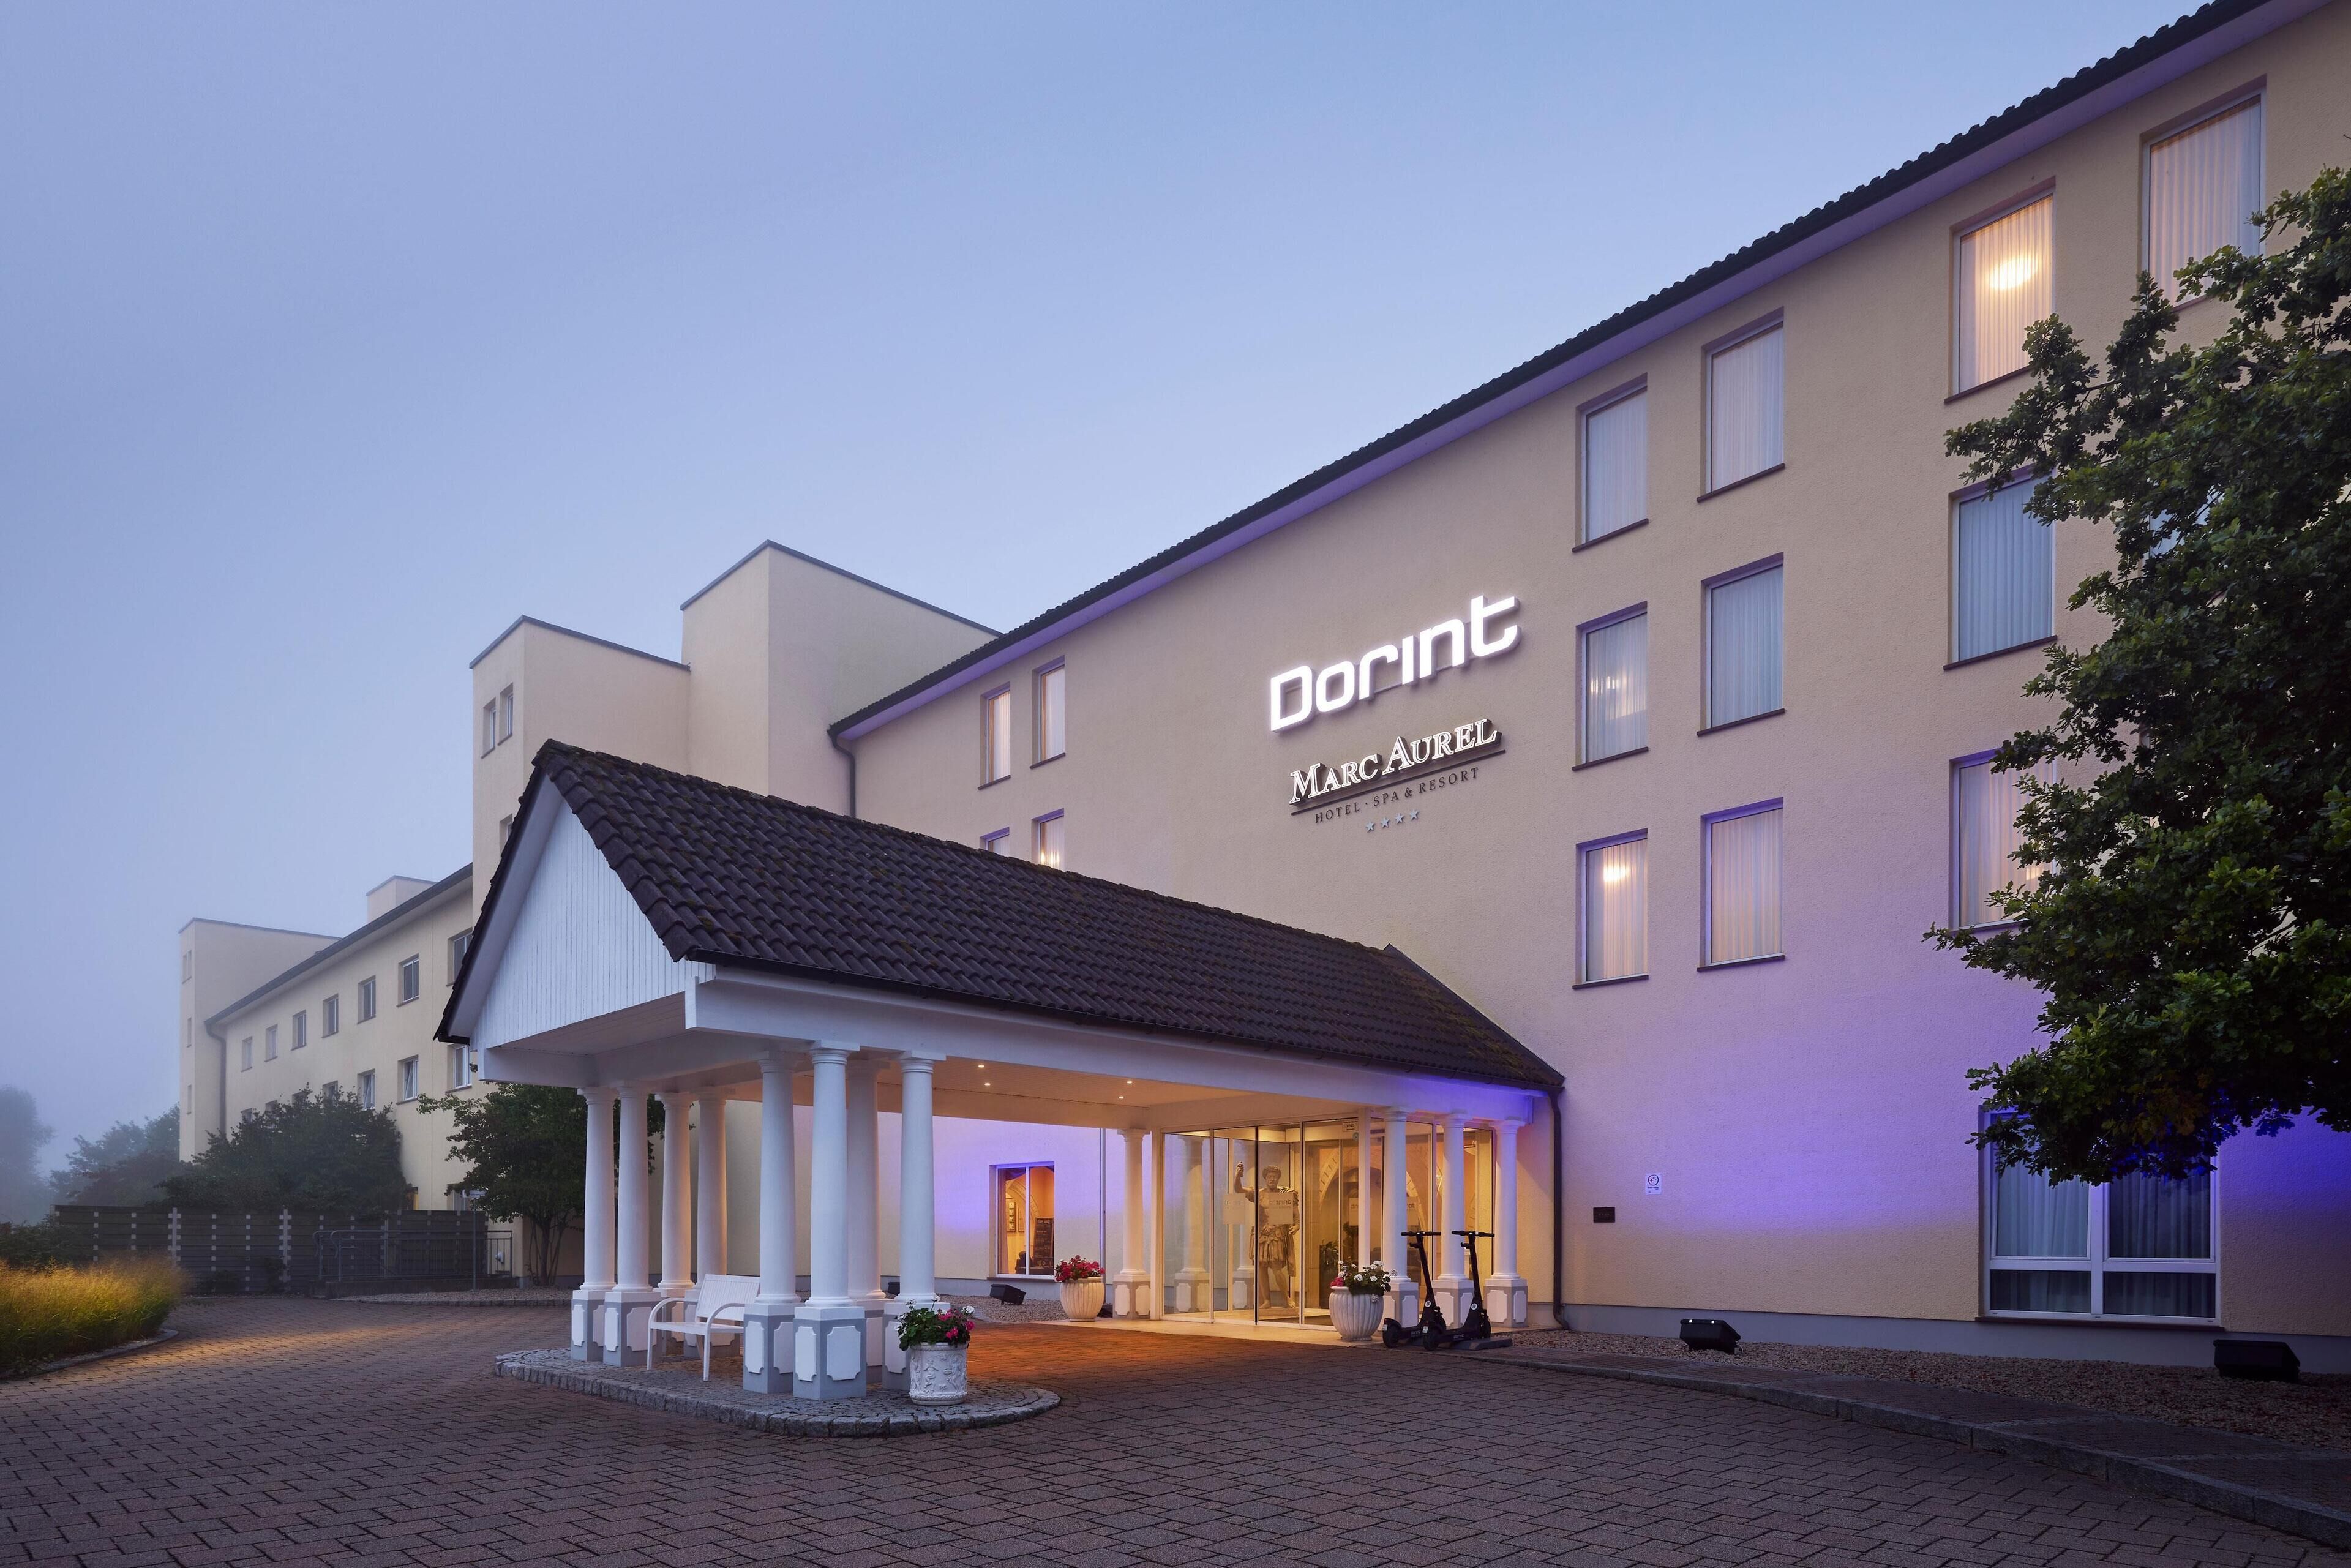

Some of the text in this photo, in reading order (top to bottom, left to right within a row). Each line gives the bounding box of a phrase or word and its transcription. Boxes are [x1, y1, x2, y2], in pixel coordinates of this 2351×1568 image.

[1270, 595, 1519, 732] Dorint
[1289, 719, 1499, 804] MARC AUREL
[1315, 767, 1479, 823] HOTEL SPA & RESORT
